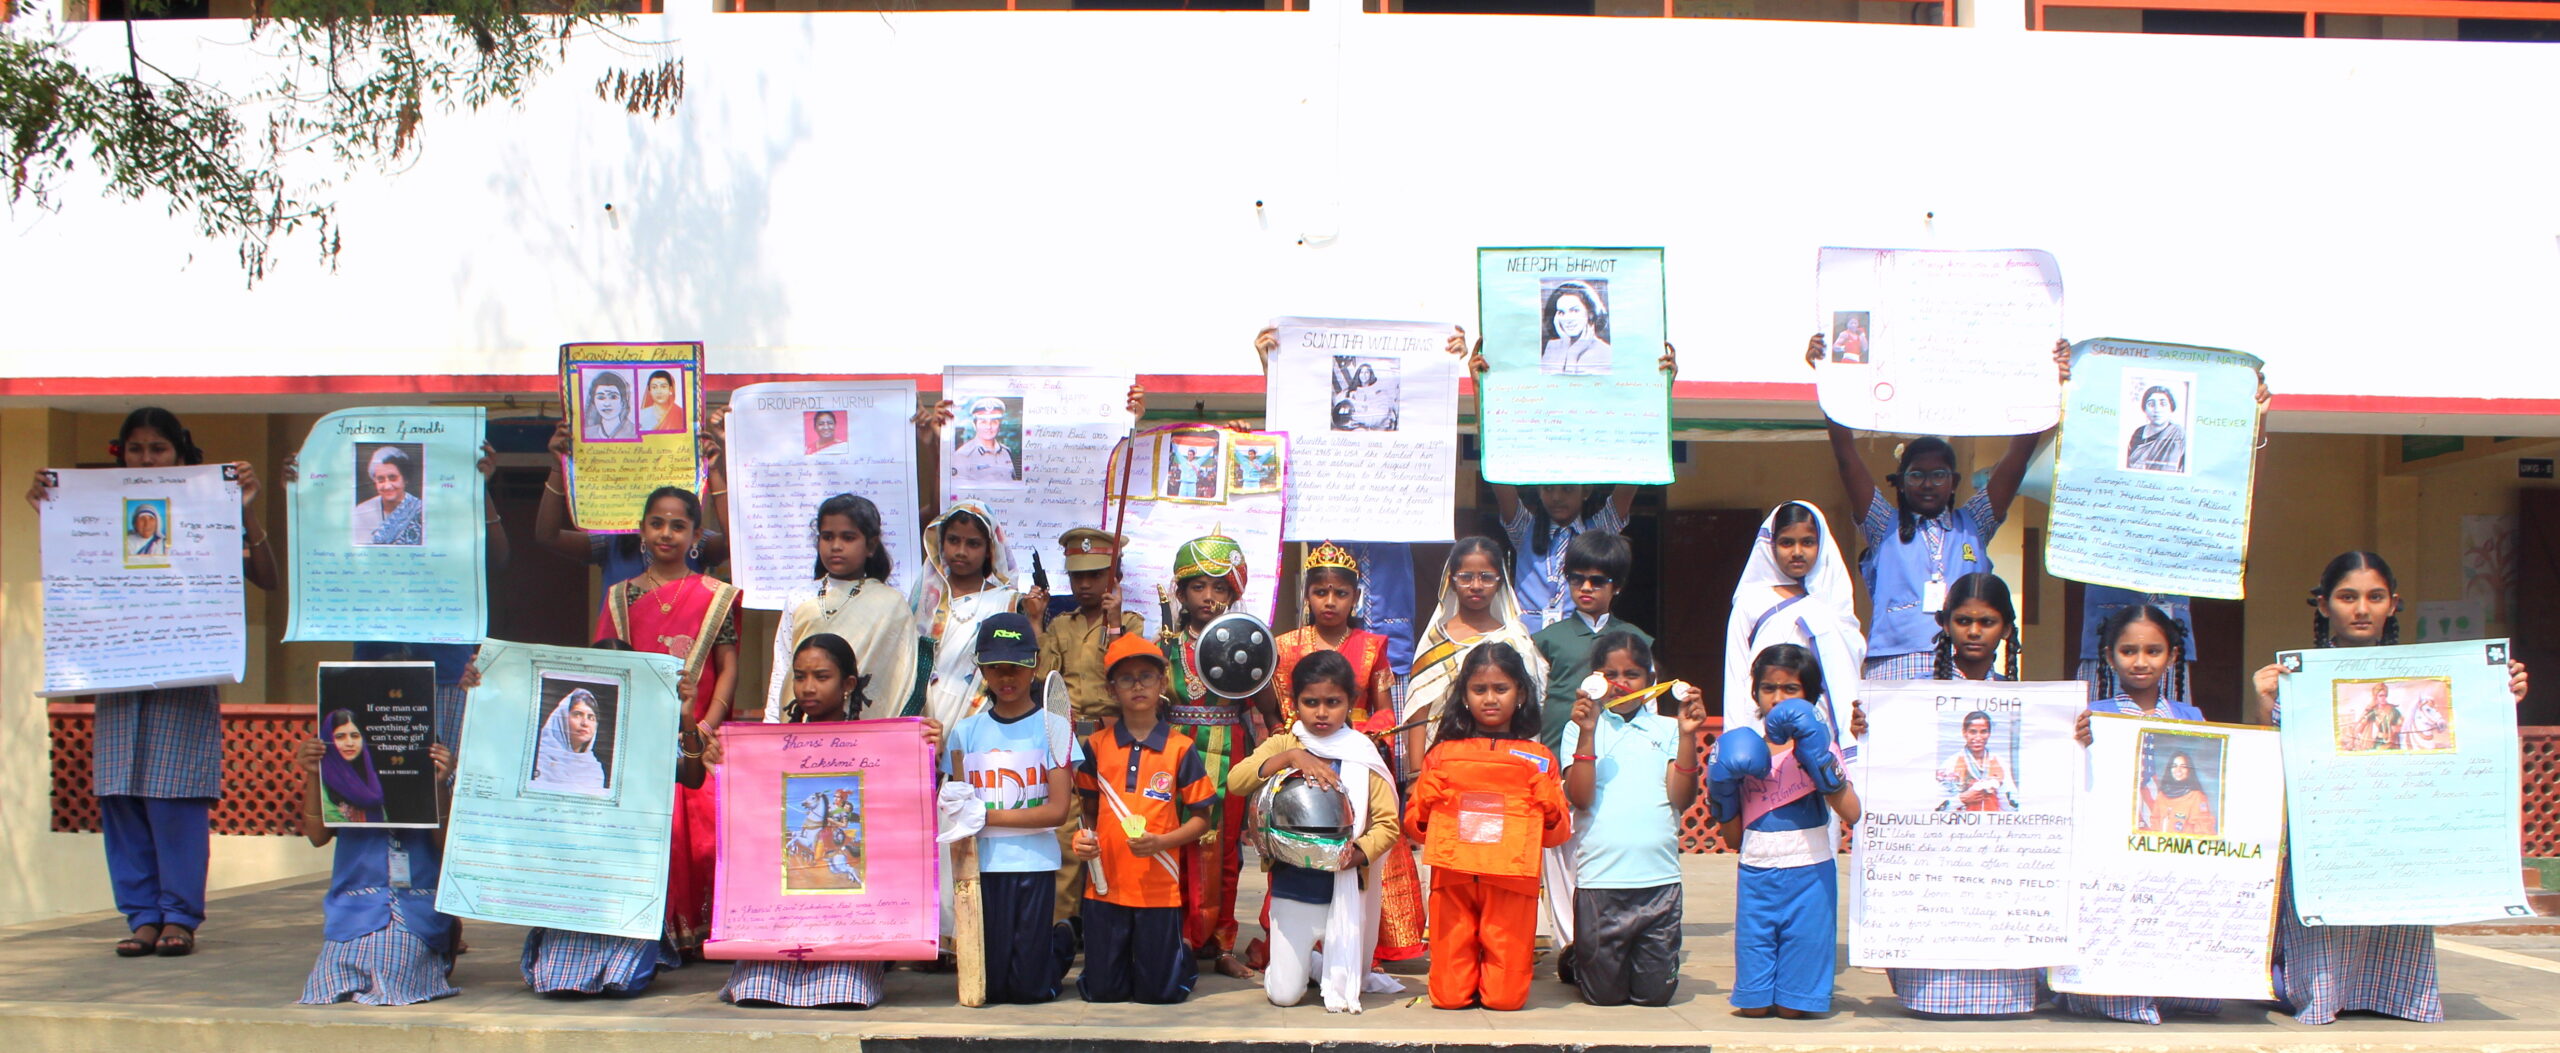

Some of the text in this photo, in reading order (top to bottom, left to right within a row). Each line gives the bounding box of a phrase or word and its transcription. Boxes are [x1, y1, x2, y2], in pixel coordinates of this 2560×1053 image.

[1566, 256, 1617, 273] BHANOT
[1302, 331, 1434, 352] SUNITHA WILLIAMS
[758, 395, 875, 410] DROUPADI MURMU
[2080, 402, 2116, 416] WOMAN
[2195, 416, 2247, 428] ACHIEVER
[366, 704, 374, 712] If
[1976, 697, 2022, 713] USHA
[382, 714, 412, 724] destroy
[412, 724, 430, 734] why
[393, 734, 408, 742] one
[410, 734, 424, 743] girl
[830, 738, 858, 748] Rani
[378, 744, 408, 752] change
[800, 756, 881, 769] Lakshmi Bai
[1865, 812, 1981, 826] PILAVULLAKANDI
[2128, 836, 2262, 858] KALPANA CHAWLA
[1926, 874, 1943, 882] THE
[1953, 876, 1985, 884] TRACK
[1991, 878, 2012, 886] AND
